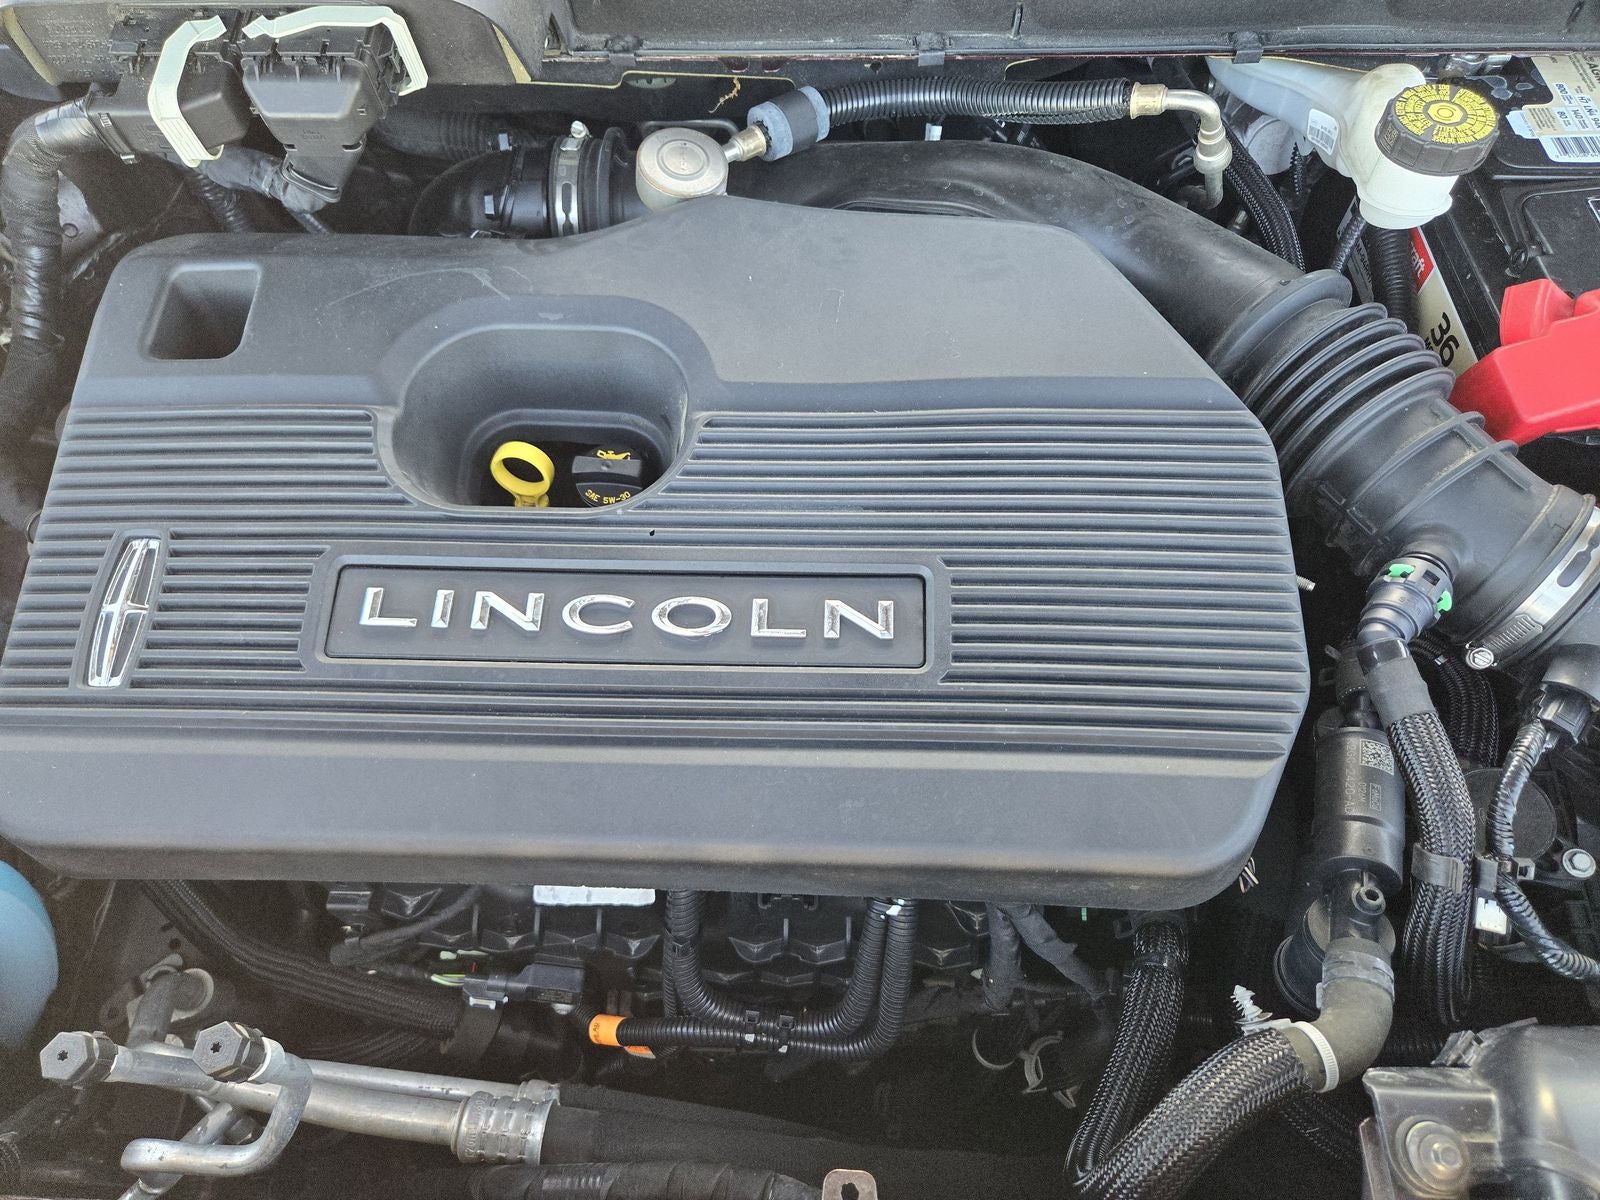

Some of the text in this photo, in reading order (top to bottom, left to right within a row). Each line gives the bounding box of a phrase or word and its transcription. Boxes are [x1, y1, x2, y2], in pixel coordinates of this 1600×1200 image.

[1430, 312, 1459, 367] 36
[585, 489, 631, 504] SAE 5W-30
[358, 586, 895, 640] LINCOLN
